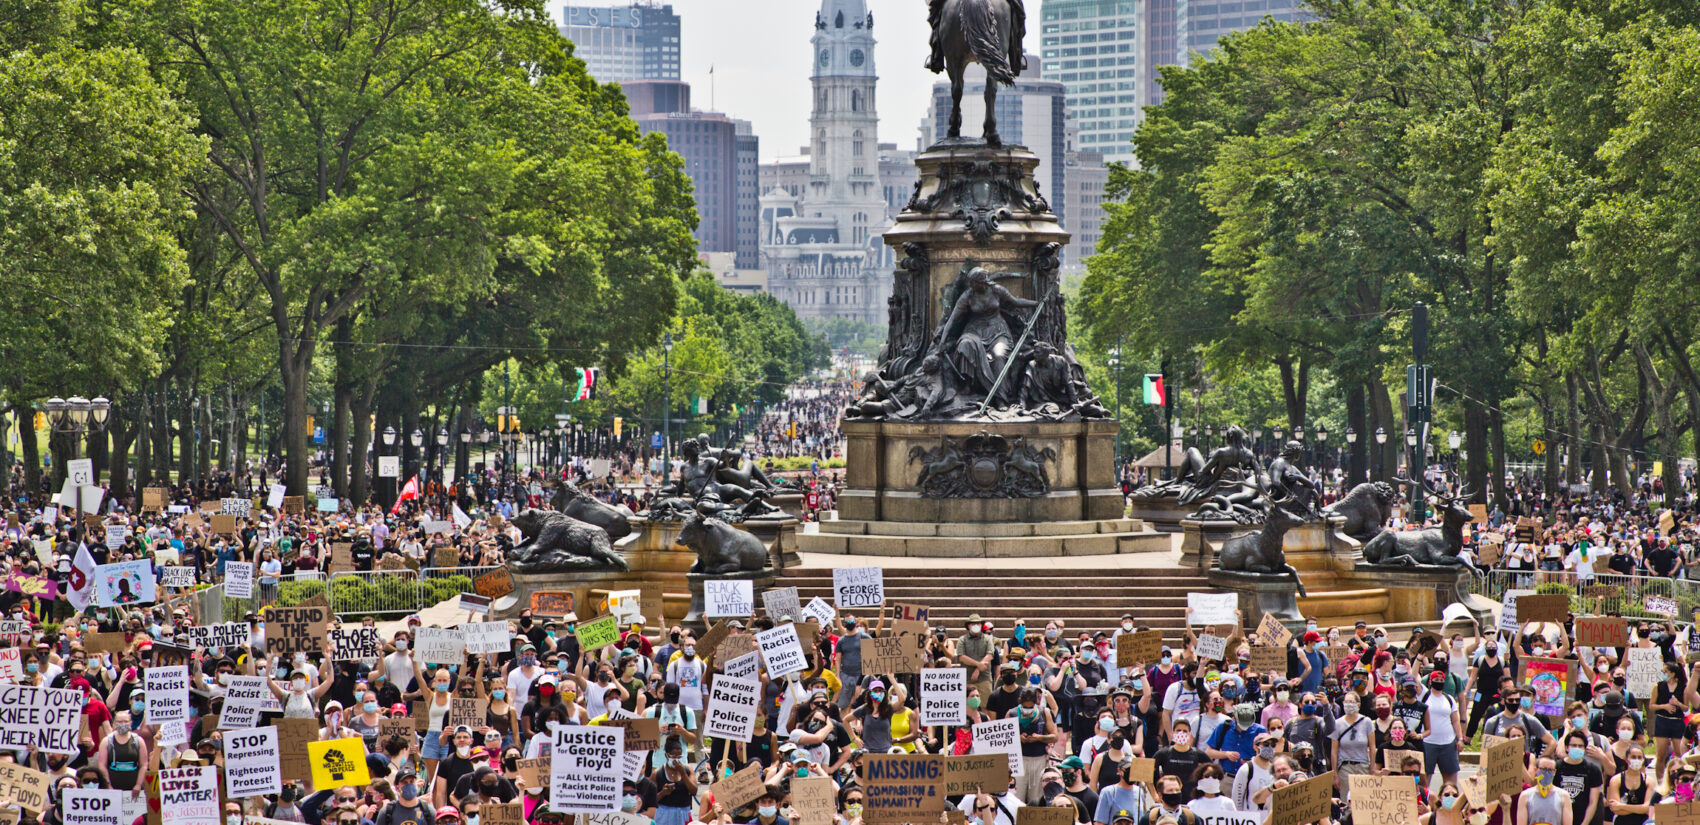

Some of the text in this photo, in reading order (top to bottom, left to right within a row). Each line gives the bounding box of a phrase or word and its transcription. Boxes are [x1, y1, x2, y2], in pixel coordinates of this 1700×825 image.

[569, 8, 641, 28] PSFS
[164, 567, 196, 577] BLACK LIVES
[860, 567, 879, 576] HIS
[164, 577, 190, 585] MATTER
[847, 575, 878, 584] NAME
[707, 582, 741, 597] BLACK
[839, 584, 880, 595] GEORGE
[714, 592, 742, 604] LIVES
[841, 593, 882, 607] FLOYD
[717, 603, 754, 614] MATTER!
[776, 607, 797, 615] STAND
[808, 603, 829, 621] Racist
[894, 605, 928, 621] BLM
[1656, 605, 1678, 614] PEACE
[265, 608, 323, 623] DEFUND
[189, 624, 248, 638] END POLICE
[281, 623, 309, 638] THE
[332, 628, 378, 640] BLACK
[419, 628, 465, 641] BLACK TRANS
[761, 627, 790, 642] NO MORE
[196, 634, 248, 648] BRUTALITY
[602, 632, 617, 642] YOU
[874, 637, 902, 648] BLACK
[1201, 637, 1224, 645] BLACK
[266, 636, 322, 653] POLICE
[336, 638, 377, 650] LIVES
[428, 641, 454, 651] LIVES
[762, 635, 796, 652] Racist
[332, 648, 379, 660] MATTER
[769, 651, 797, 665] Police
[876, 647, 903, 657] LIVES
[1632, 651, 1657, 661] BLACK
[727, 655, 754, 671] NO MORE
[771, 657, 800, 672] Terror!
[862, 656, 913, 674] MATTER
[1632, 662, 1657, 672] LIVES
[161, 670, 183, 678] MORE
[939, 672, 961, 680] MORE
[1627, 673, 1662, 682] MATTER
[147, 679, 185, 691] Racist
[716, 679, 755, 693] NO MORE
[923, 681, 963, 692] Racist
[1, 688, 82, 707] GET YOUR
[227, 688, 260, 699] Racist
[713, 689, 755, 706] Racist
[150, 698, 183, 708] Police
[452, 698, 476, 709] BLACK
[926, 699, 960, 709] Police
[150, 707, 183, 717] Terror!
[226, 705, 255, 715] Police
[452, 708, 477, 717] LIVES
[926, 710, 959, 719] Terror!
[0, 708, 79, 725] KNEE OFF
[223, 715, 252, 723] Terror!
[451, 716, 484, 727] MATTER
[713, 709, 748, 724] Police
[379, 726, 411, 737] JUSTICE
[710, 720, 746, 734] Terror!
[975, 722, 1014, 738] Justice
[38, 728, 79, 751] NECK
[232, 734, 268, 749] STOP
[555, 730, 616, 747] Justice
[984, 730, 1015, 741] George
[990, 738, 1014, 748] Floyd
[227, 748, 275, 760] Repressing
[569, 745, 617, 759] George
[1491, 746, 1517, 761] BLACK
[332, 760, 354, 769] JUSTICE
[576, 757, 612, 771] Floyd
[947, 761, 962, 773] NO
[963, 759, 996, 770] JUSTICE
[1491, 760, 1515, 777] LIVES
[161, 767, 203, 779] BLACK
[229, 765, 275, 777] Righteous
[868, 760, 944, 781] MISSING:
[233, 776, 273, 788] Protest!
[566, 773, 582, 782] ALL
[584, 774, 616, 783] Victims
[1353, 778, 1384, 788] KNOW
[162, 780, 200, 792] LIVES
[562, 782, 616, 792] Racist Police
[721, 781, 734, 793] NO
[867, 785, 936, 797] COMPASSION &
[947, 781, 984, 792] NO PEACE
[1489, 775, 1519, 795] MATTER
[9, 786, 42, 807] FLOYD
[163, 788, 217, 805] MATTER!
[576, 792, 616, 801] Violence!
[802, 786, 821, 797] SAY
[1276, 782, 1311, 801] WHITE
[1370, 790, 1411, 802] JUSTICE
[71, 797, 111, 811] STOP
[725, 789, 761, 810] NO PEACE
[868, 797, 923, 808] HUMANITY
[1276, 789, 1328, 814] SILENCE IS
[1354, 800, 1384, 811] KNOW
[163, 806, 216, 819] NO JUSTICE
[481, 806, 494, 820] WE
[801, 810, 832, 823] NAMES
[1019, 809, 1037, 821] NO
[1276, 803, 1327, 825] VIOLENCE
[1371, 811, 1409, 825] PEACE
[66, 813, 118, 825] Repressing
